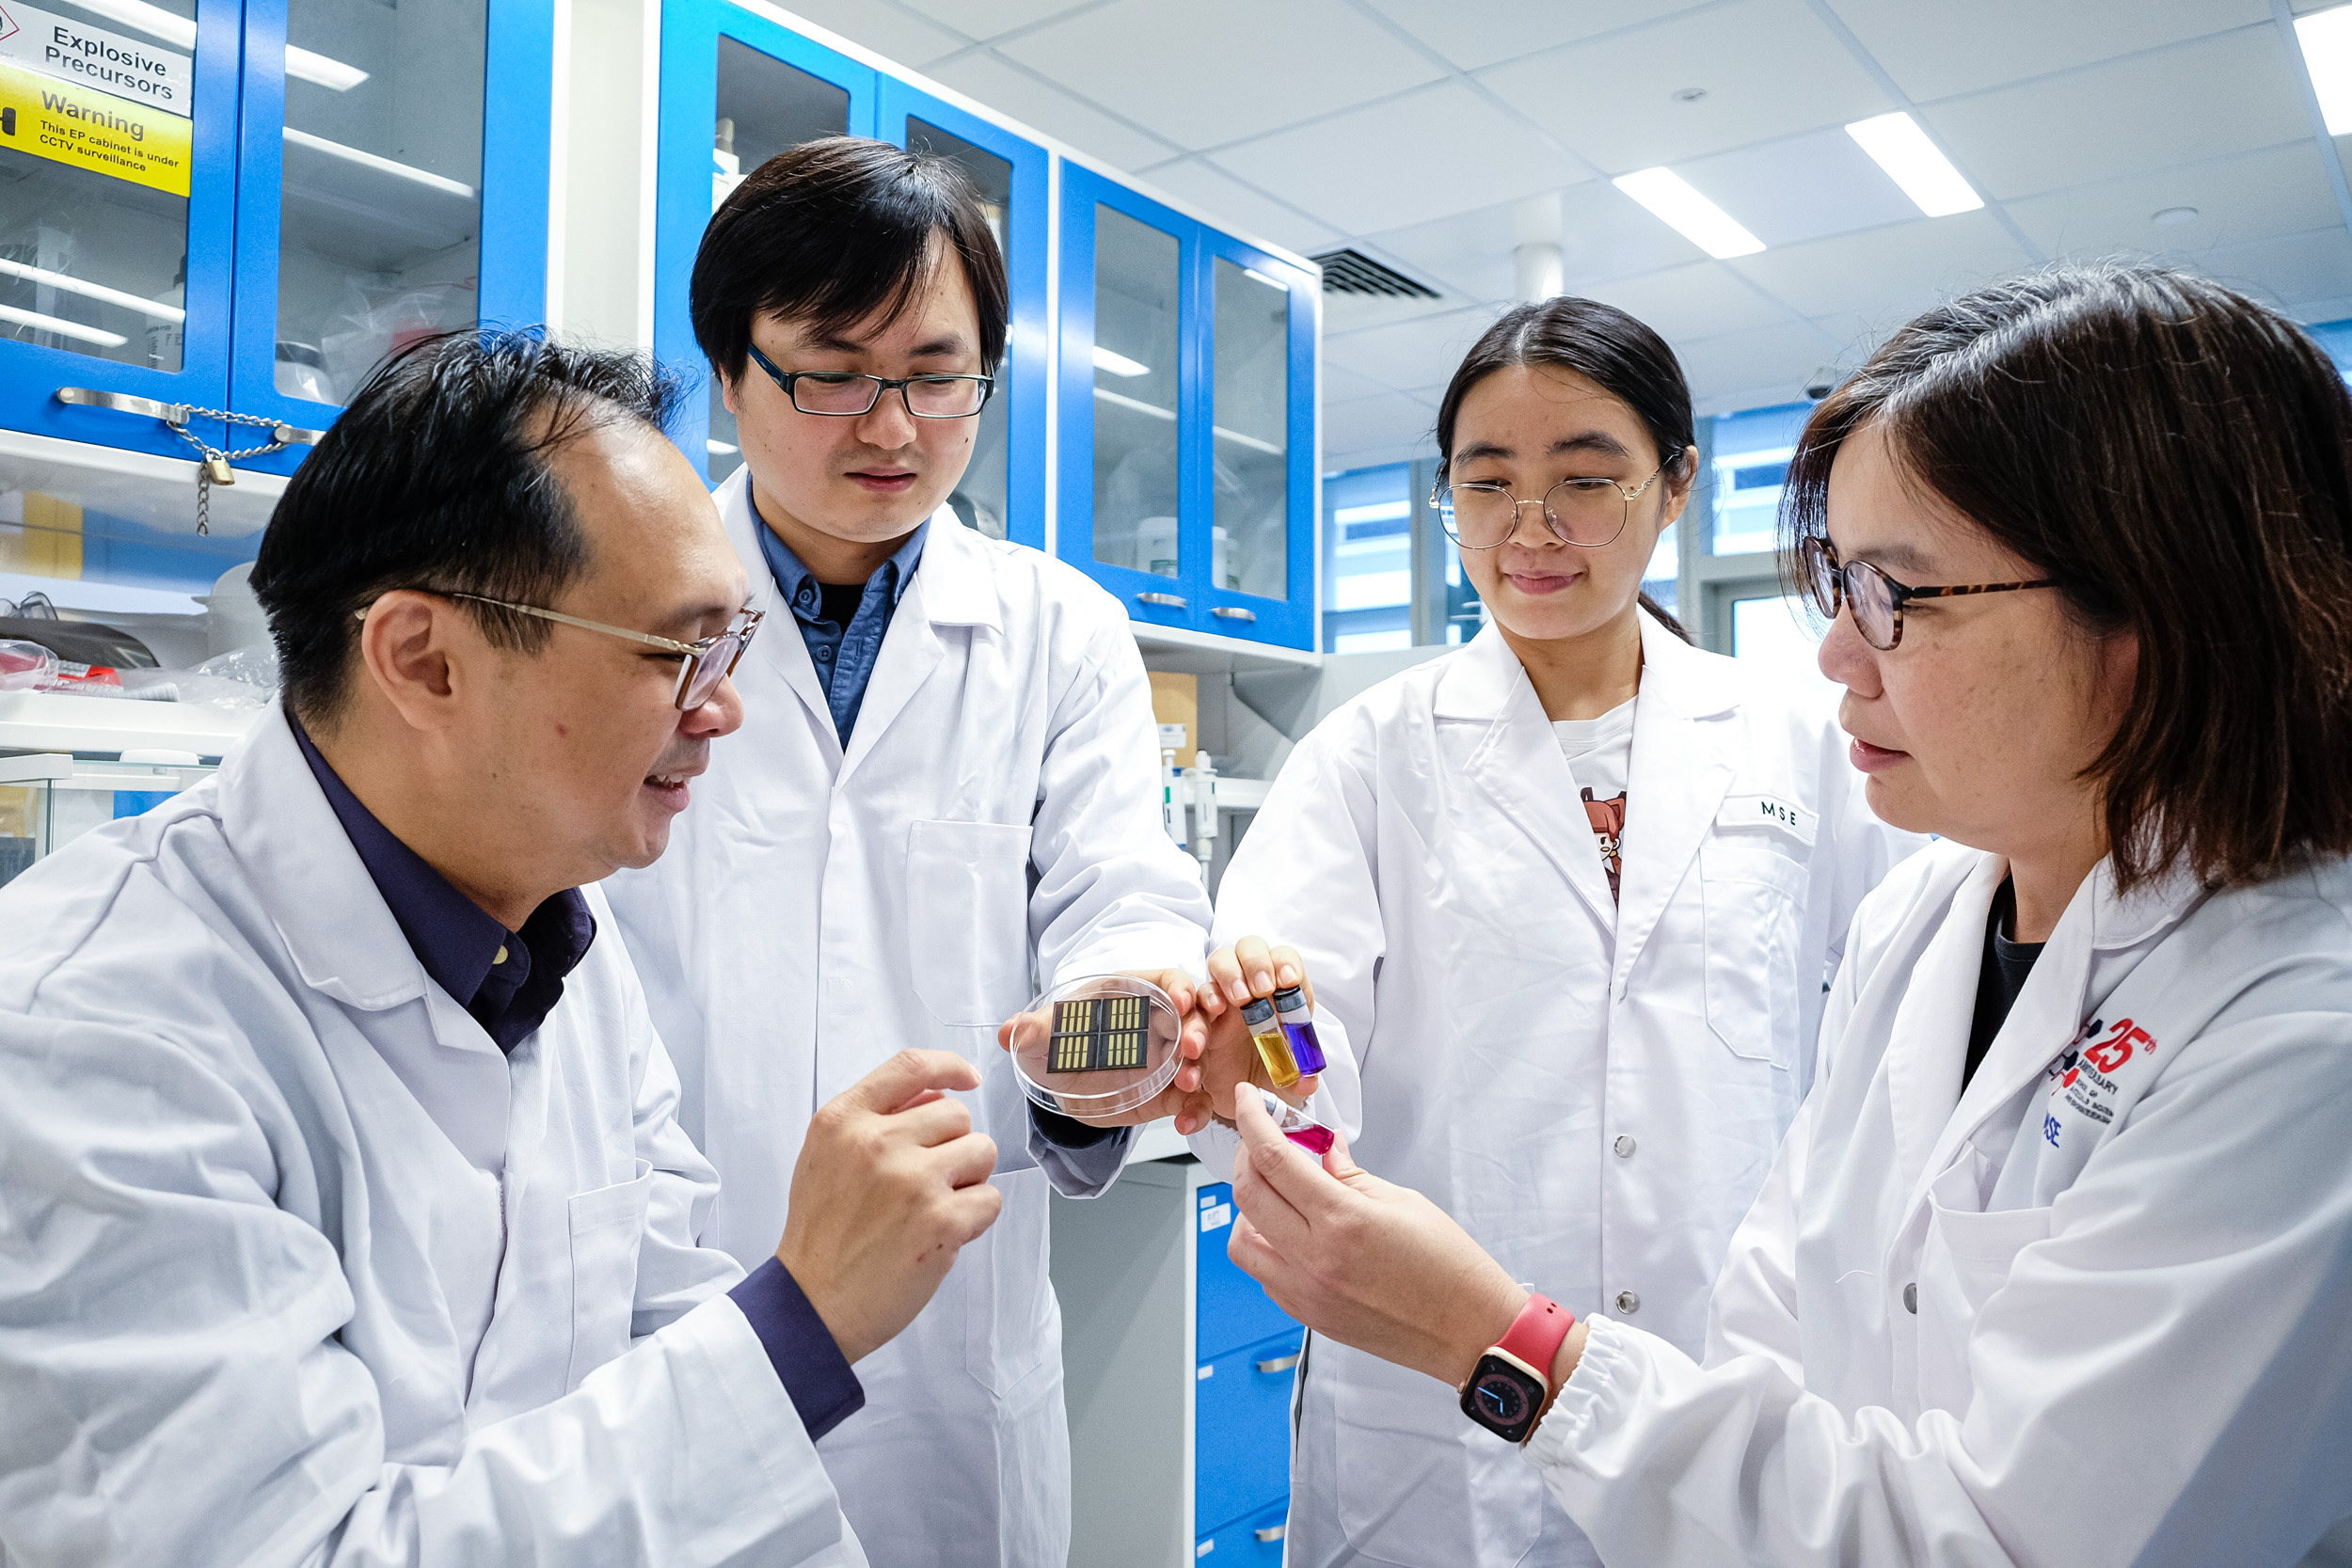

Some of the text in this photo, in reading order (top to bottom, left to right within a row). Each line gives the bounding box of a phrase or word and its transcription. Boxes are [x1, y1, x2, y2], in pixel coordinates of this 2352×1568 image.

[45, 45, 173, 100] Precursors
[54, 25, 167, 76] Explosive
[41, 90, 144, 141] Warning
[40, 119, 179, 167] This EP cabinet is under
[40, 135, 146, 171] CCTV surveillance
[1761, 801, 1796, 826] MSE
